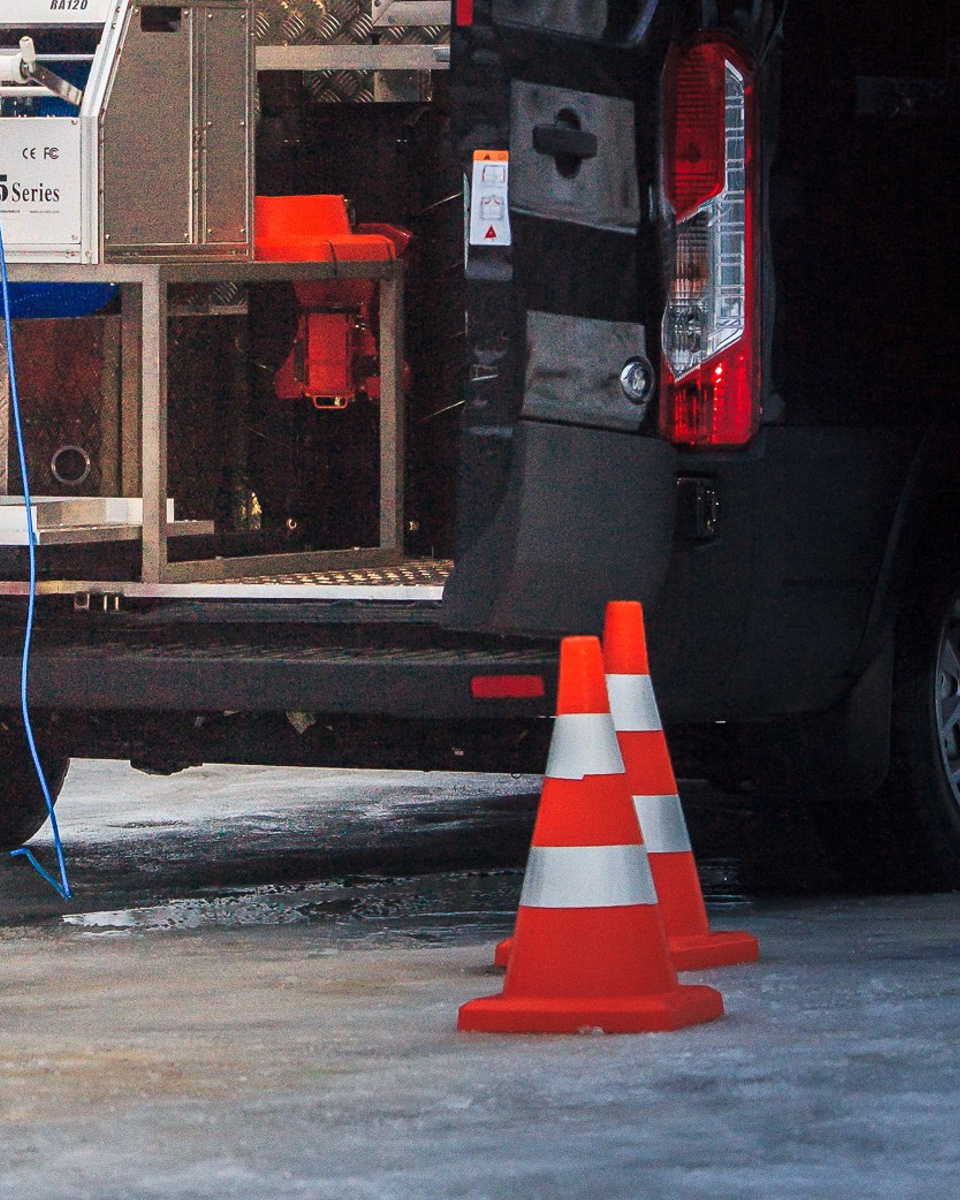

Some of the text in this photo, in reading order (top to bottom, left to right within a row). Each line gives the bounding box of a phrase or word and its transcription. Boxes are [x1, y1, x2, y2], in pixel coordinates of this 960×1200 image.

[50, 0, 89, 10] RA120
[22, 147, 36, 160] CE
[11, 181, 60, 203] Series
